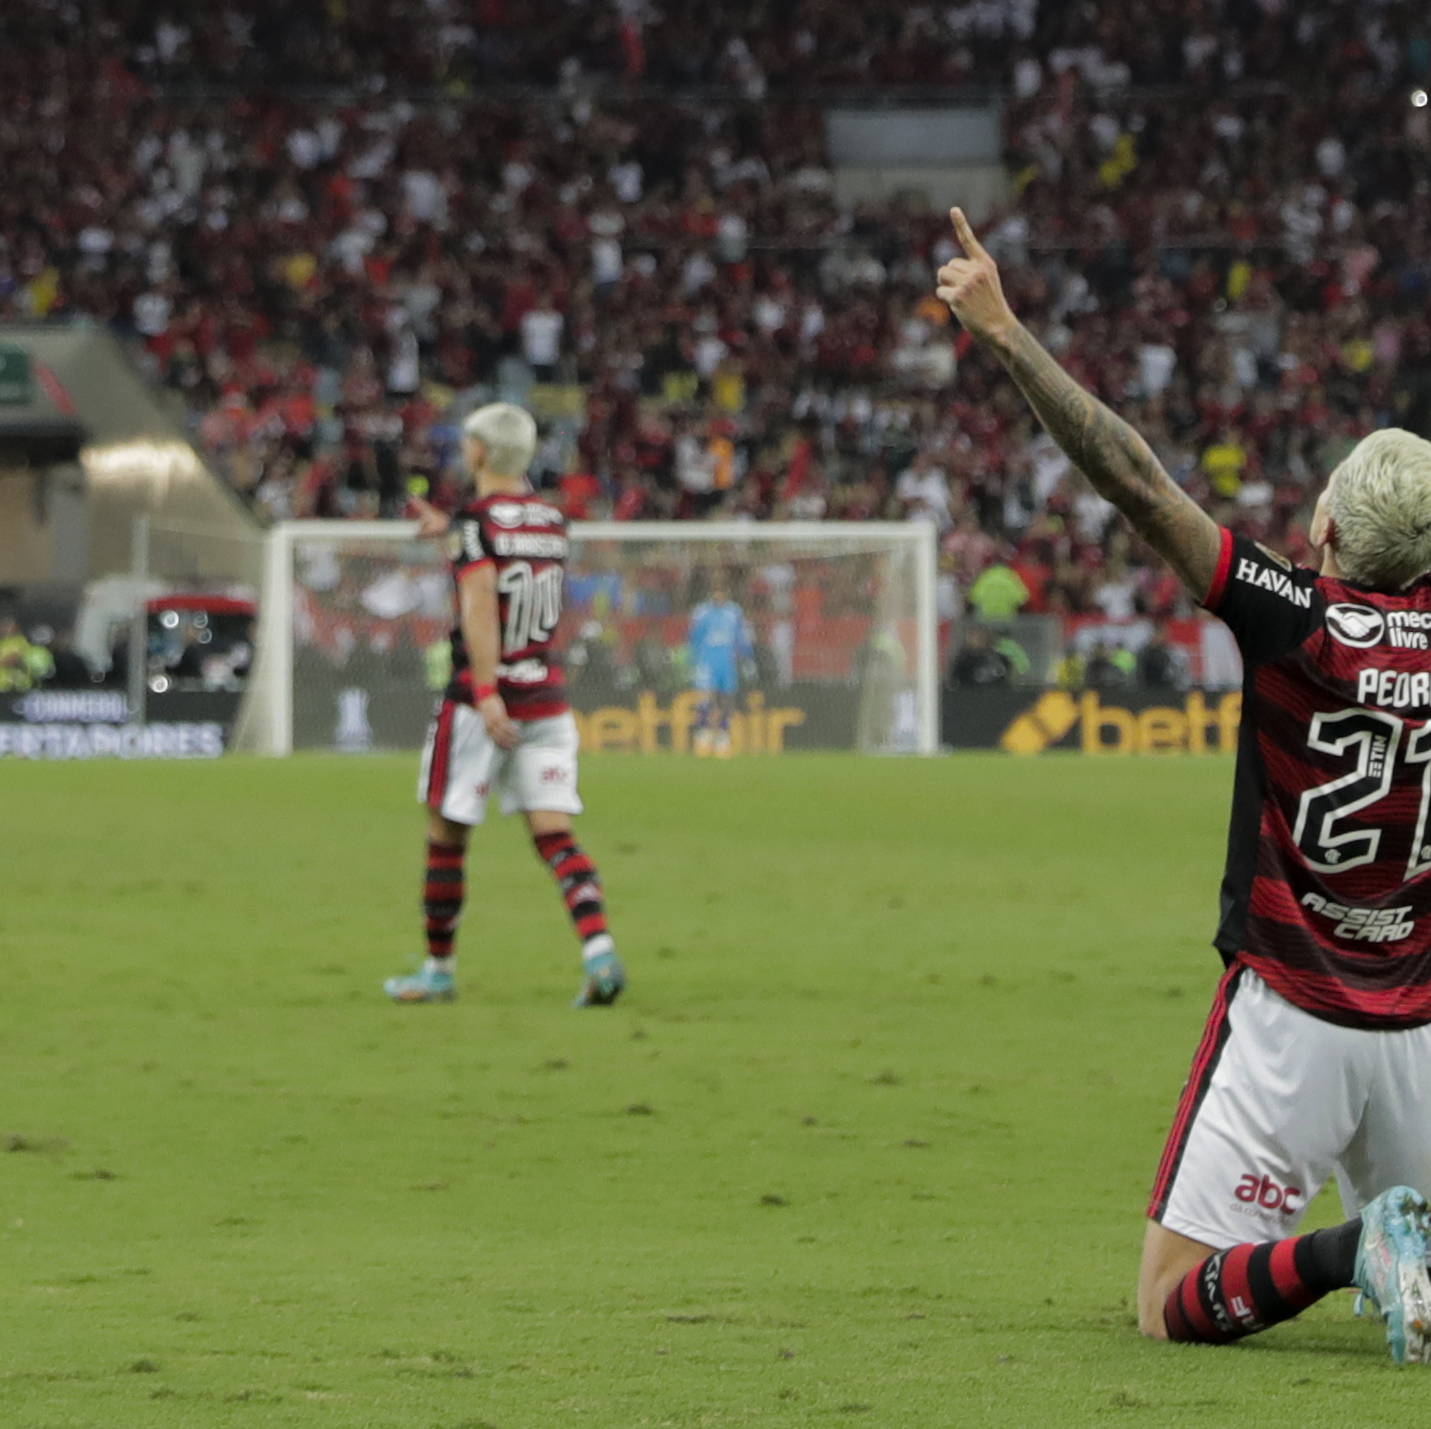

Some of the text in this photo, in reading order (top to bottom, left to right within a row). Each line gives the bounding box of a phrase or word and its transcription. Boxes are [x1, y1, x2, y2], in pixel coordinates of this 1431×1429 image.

[1235, 557, 1312, 609] HAVAN
[1389, 627, 1429, 650] livre
[1301, 892, 1414, 926] ASSIST
[1333, 920, 1415, 943] CARD
[1234, 1173, 1302, 1215] abc
